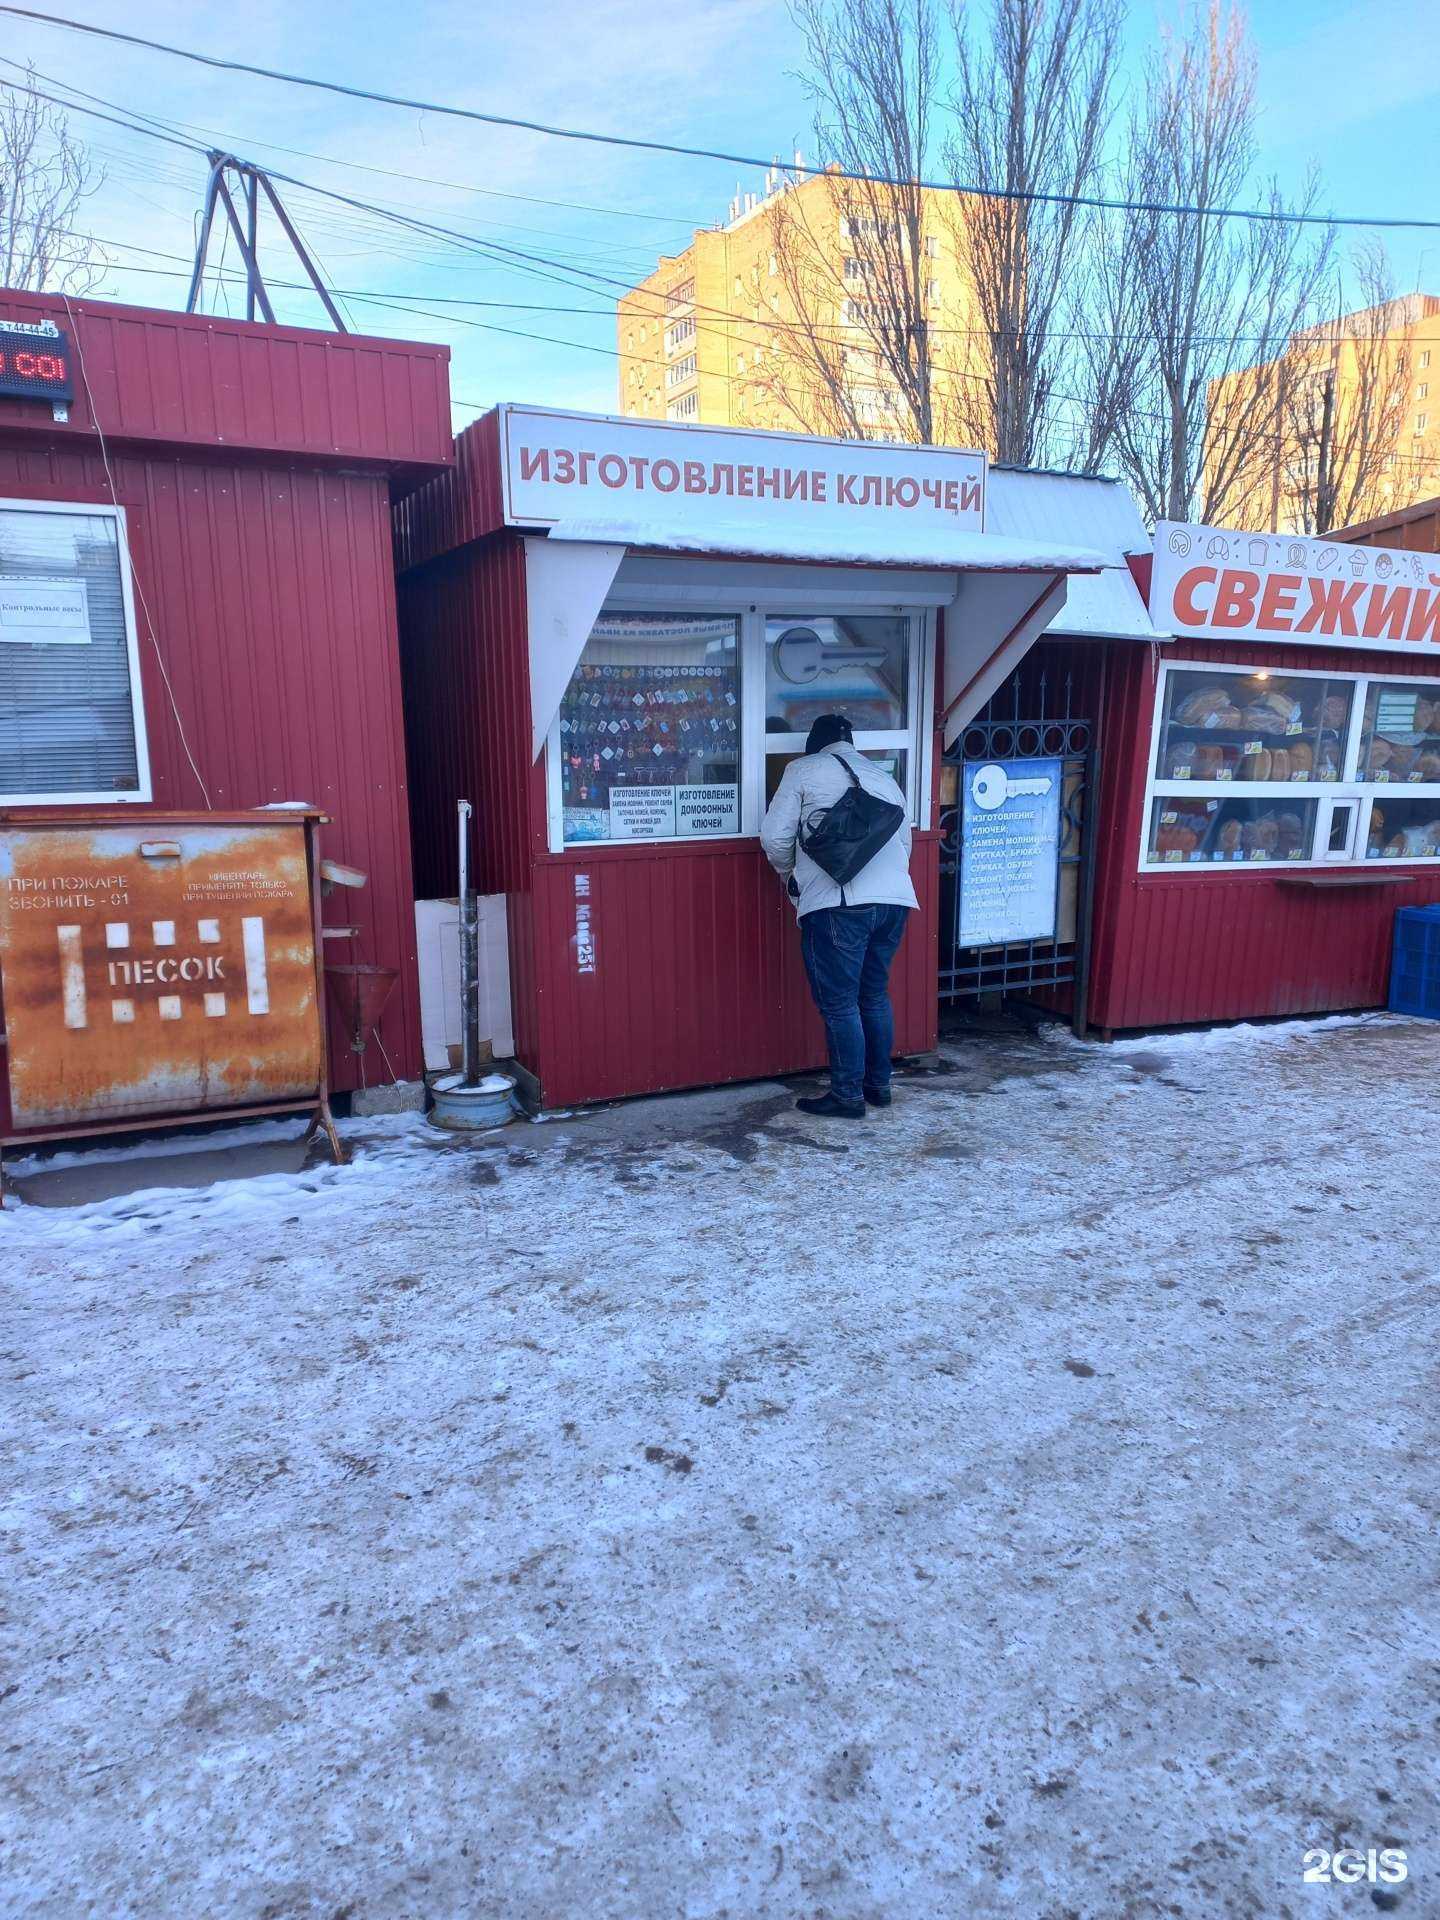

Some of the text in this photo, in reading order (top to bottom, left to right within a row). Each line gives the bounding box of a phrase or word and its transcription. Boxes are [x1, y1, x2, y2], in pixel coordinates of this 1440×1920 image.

[519, 446, 981, 512] ИЗГОТОВЛЕНИЕ КЛЮЧЕЙ
[1172, 565, 1440, 643] СВЕЖИЙ
[613, 789, 650, 798] ИЗГОТОВЛЕНИЕ
[680, 789, 735, 800] ИЗГОТОВЛЕНИЕ
[681, 803, 733, 816] ДОМОФОННЫХ
[692, 816, 722, 829] КЛЮЧЕЙ
[972, 811, 1035, 822] ИЗГОТОВЛЕНИЕ
[972, 838, 1004, 848] ЗАМЕНА
[8, 875, 128, 891] ПРИ ПОЖАРЕ
[9, 894, 95, 909] ЗВОНИТЬ
[111, 893, 129, 905] 01
[108, 955, 225, 985] ПЕСОК
